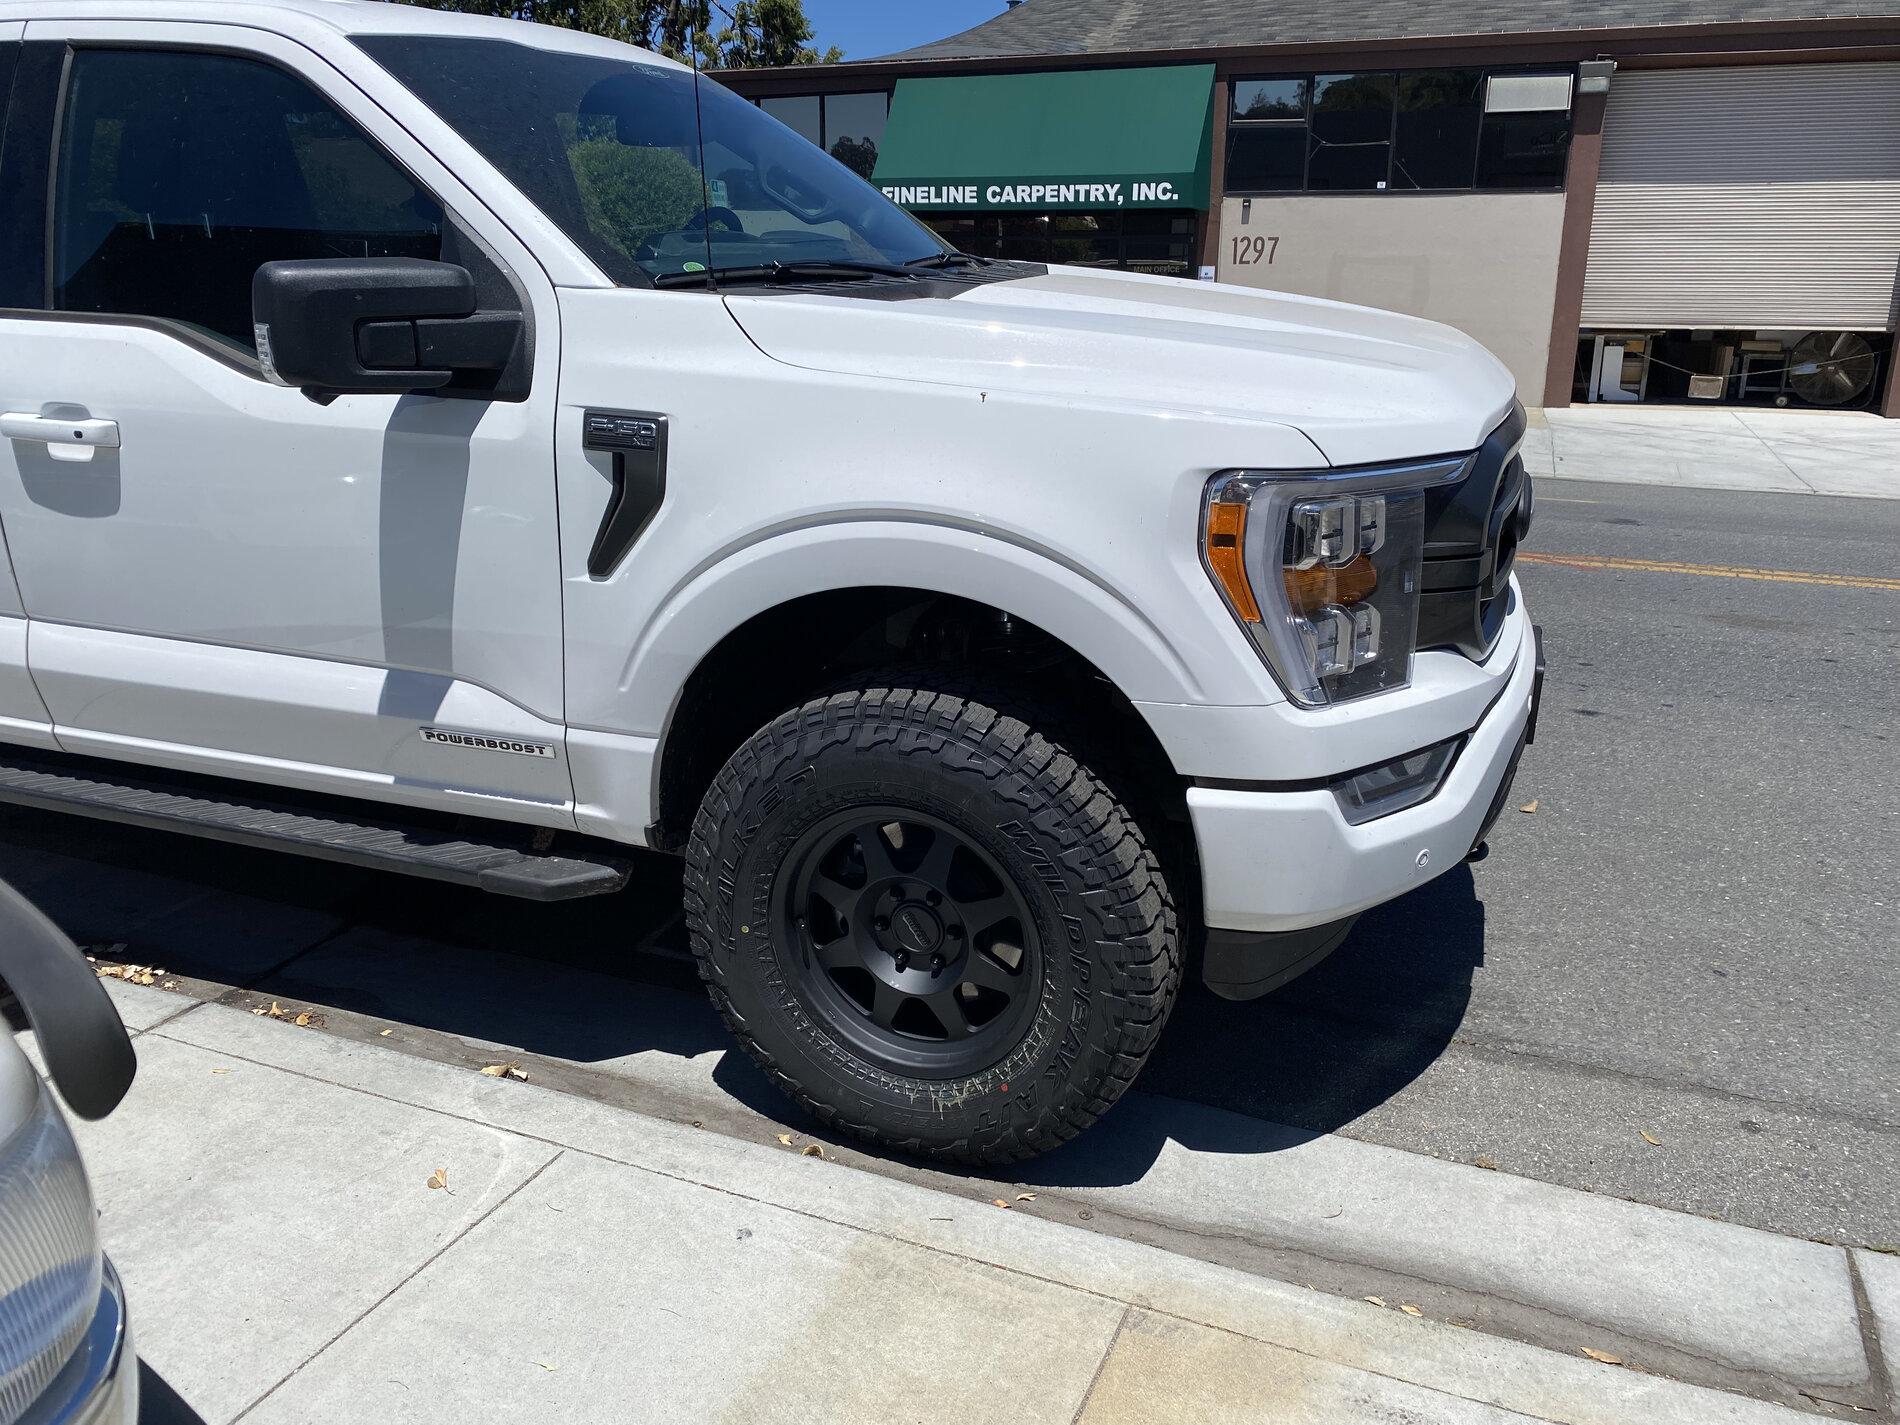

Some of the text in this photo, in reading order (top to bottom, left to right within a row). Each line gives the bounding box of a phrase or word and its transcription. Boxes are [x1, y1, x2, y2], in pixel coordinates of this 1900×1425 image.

[986, 184, 1123, 205] CARPENTRY,
[1132, 182, 1179, 200] INC.
[1232, 236, 1280, 265] 1297
[1133, 264, 1180, 273] MAIN OFFICE
[589, 417, 656, 438] F-150
[425, 731, 546, 755] POWERBOOST
